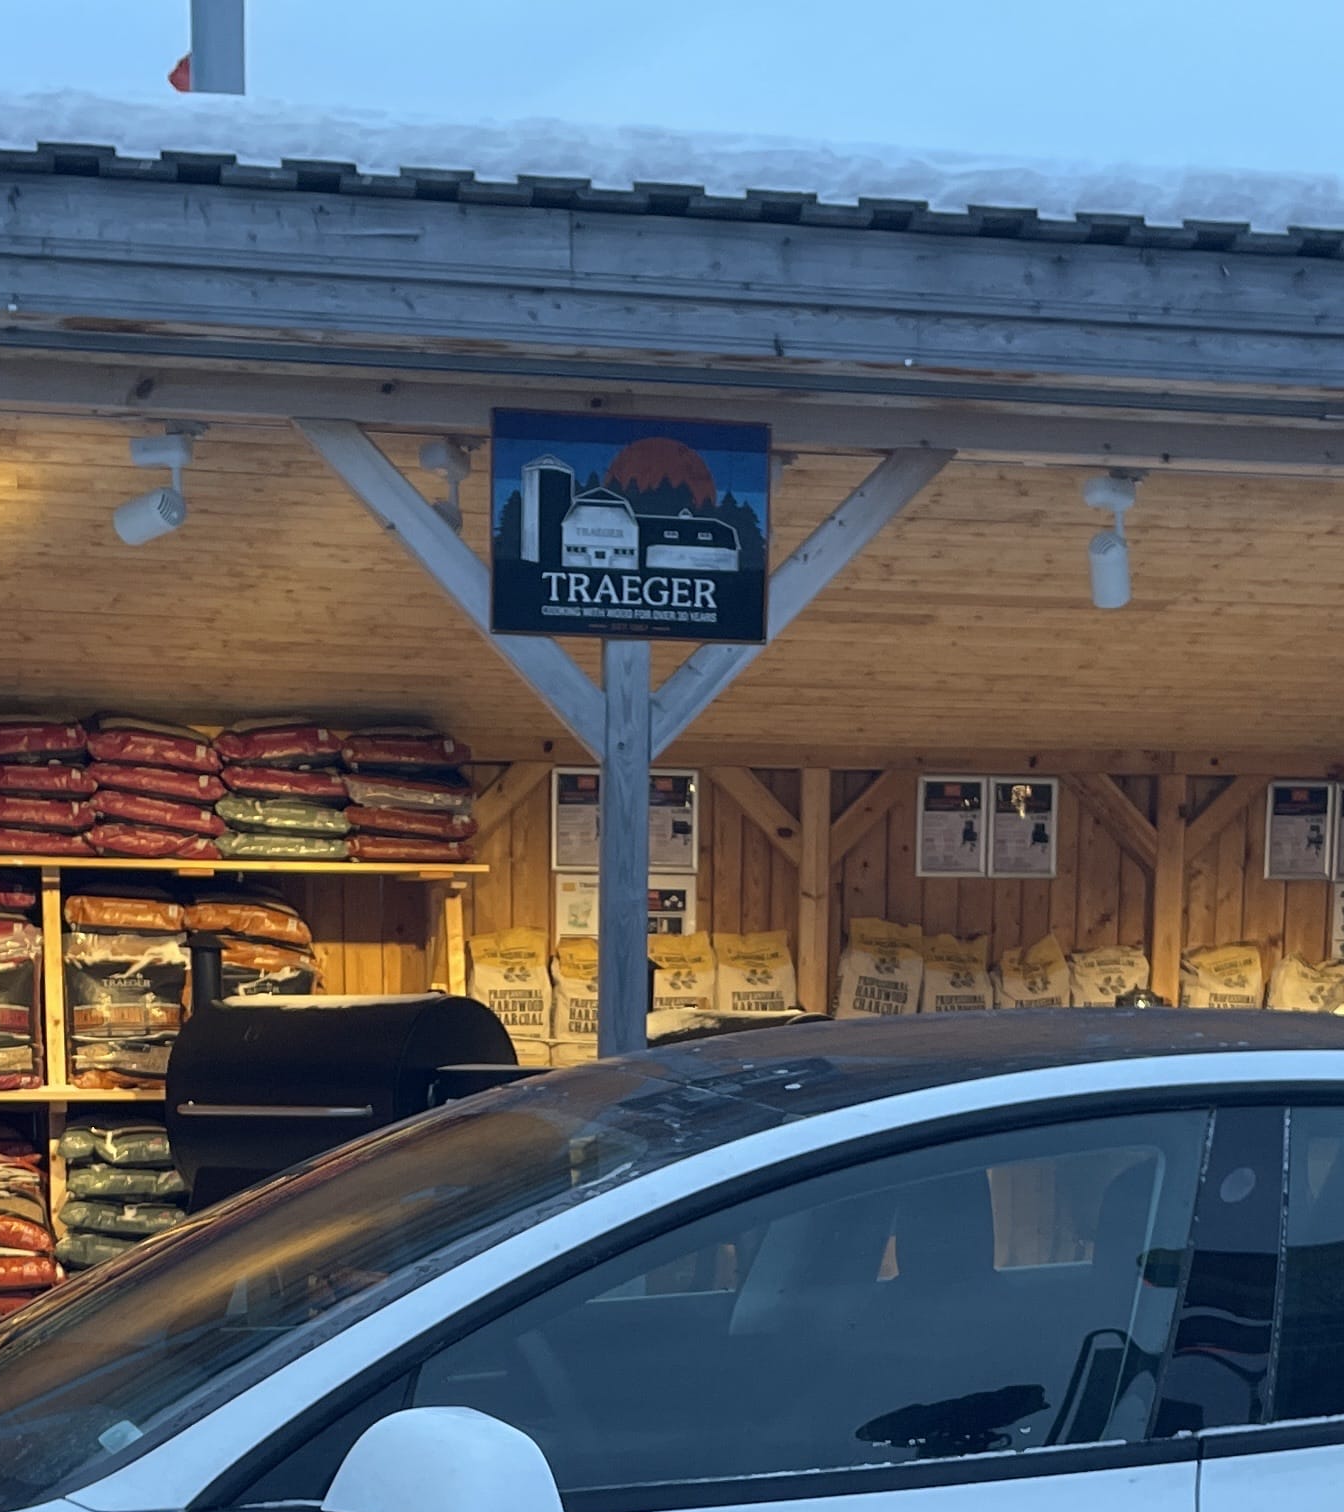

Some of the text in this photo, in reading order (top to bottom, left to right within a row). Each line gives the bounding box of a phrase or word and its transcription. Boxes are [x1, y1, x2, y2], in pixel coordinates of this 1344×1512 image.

[542, 571, 718, 609] TRAEGER
[102, 977, 151, 989] TRAEGER
[489, 1000, 544, 1012] HARDWOOD
[568, 1021, 599, 1033] CHAR
